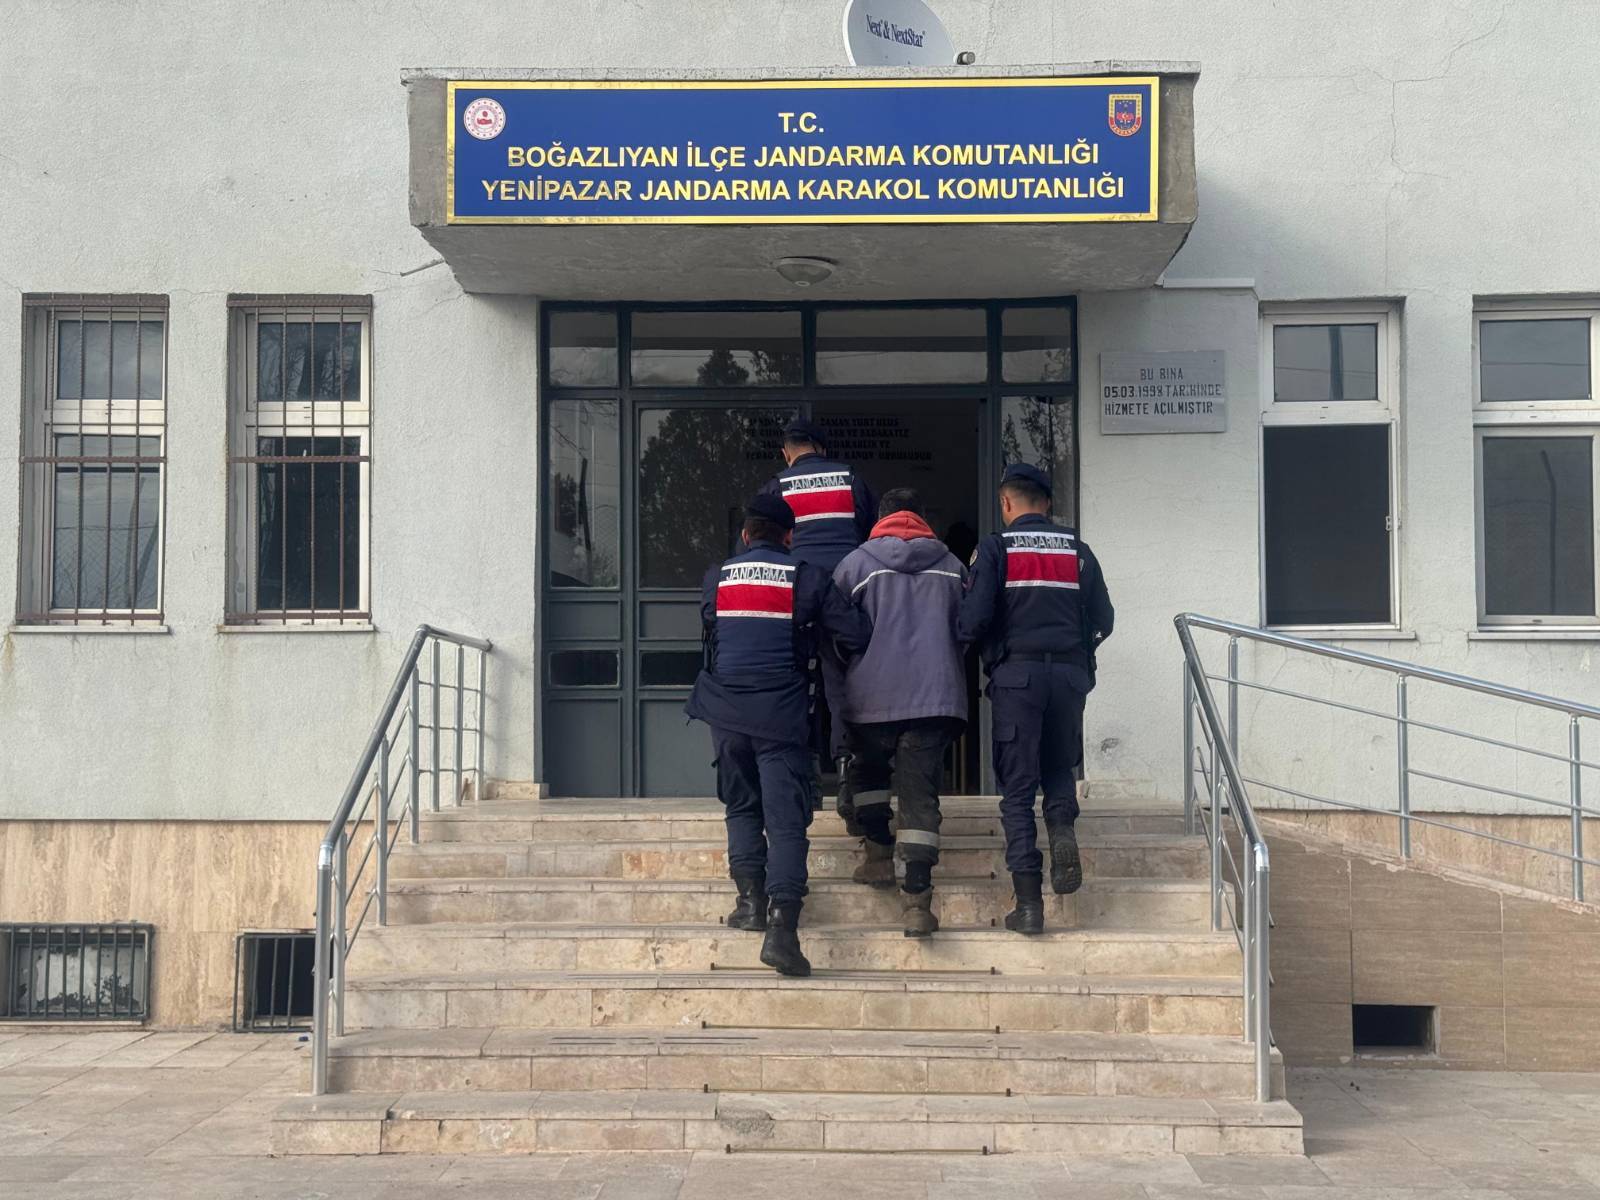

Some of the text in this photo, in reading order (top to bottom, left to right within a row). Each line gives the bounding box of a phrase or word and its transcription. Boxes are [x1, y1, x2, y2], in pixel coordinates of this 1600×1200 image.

[883, 20, 891, 40] &
[778, 112, 824, 134] T.C.
[507, 137, 1099, 172] BOĞAZLIYAN İLÇE JANDARMA KOMUTANLIĞI
[481, 171, 1124, 201] YENİPAZAR JANDARMA KARAKOL KOMUTANLIĞI
[1140, 368, 1154, 381] BU
[788, 476, 846, 491] JANDARMA
[1012, 535, 1071, 549] JANDARMA
[726, 566, 788, 583] JANDARMA
